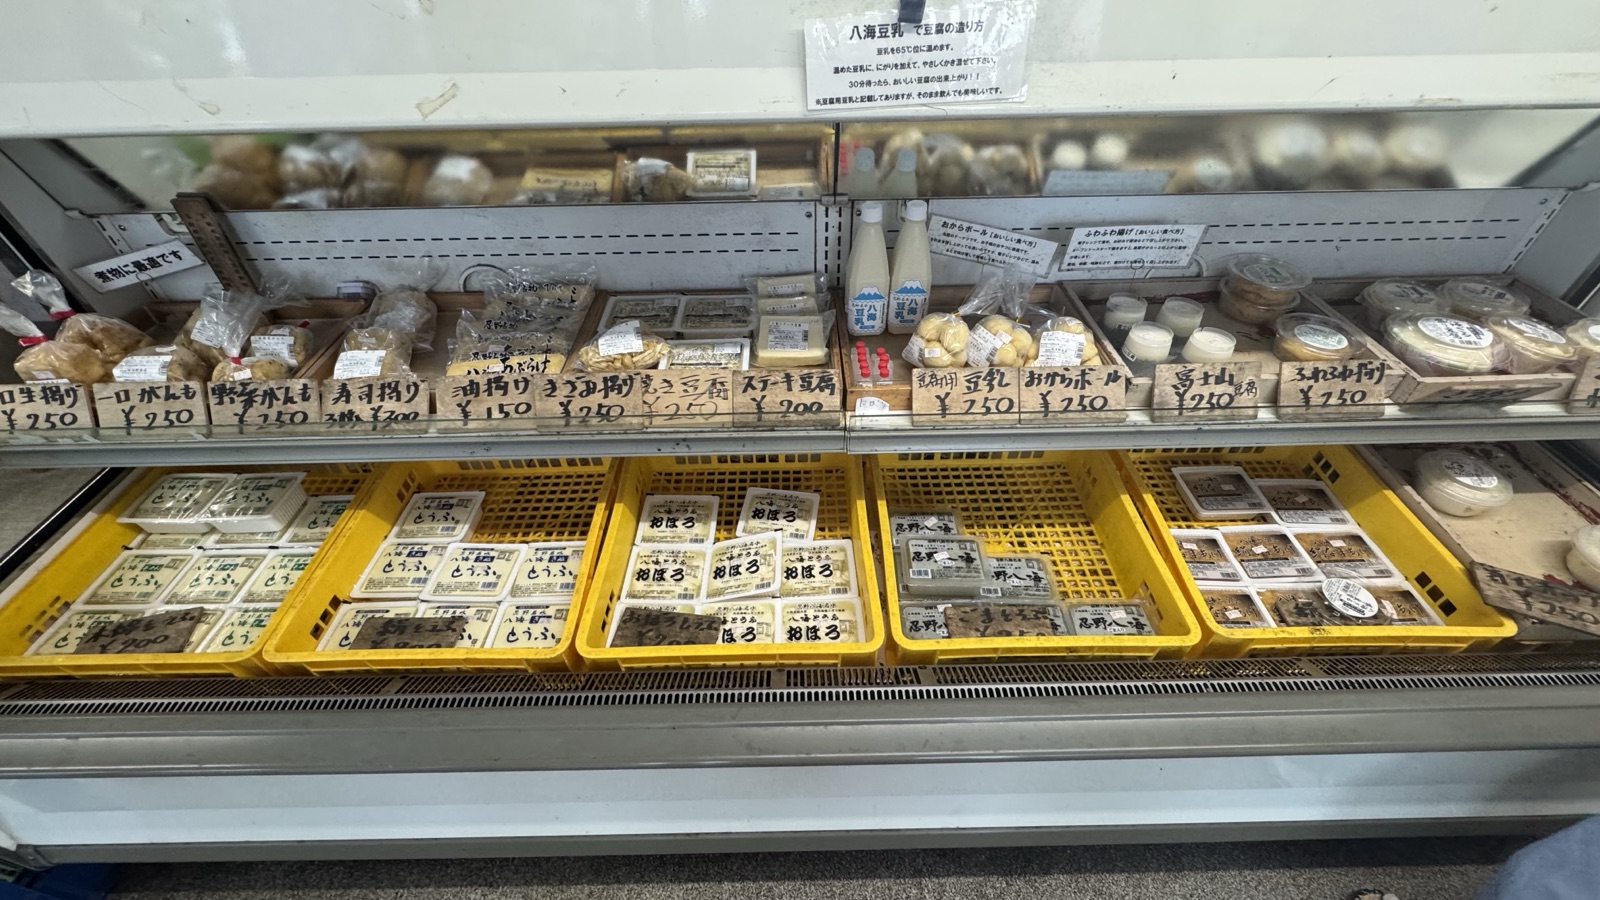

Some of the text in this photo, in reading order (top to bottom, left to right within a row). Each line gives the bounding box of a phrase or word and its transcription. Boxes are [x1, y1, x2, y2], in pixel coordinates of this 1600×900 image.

[849, 19, 984, 41] 八海豆乳 で豆腐の造り方
[941, 220, 988, 236] おからボール
[94, 248, 183, 284] 煮物に最適です
[866, 304, 877, 321] 八海
[907, 298, 918, 315] 八海
[741, 370, 836, 396] ステーキ豆腐
[1024, 367, 1122, 390] おからボール
[97, 384, 197, 405] 一口がんも
[121, 405, 194, 436] ¥250
[649, 516, 696, 529] おぼろ
[751, 507, 797, 522] おぼろ
[527, 565, 573, 580] とうふ
[635, 568, 685, 582] おぼろ
[712, 559, 760, 581] おぼろ
[784, 563, 833, 580] おぼろ
[721, 627, 757, 643] ぼろ
[786, 624, 841, 641] おぼろ
